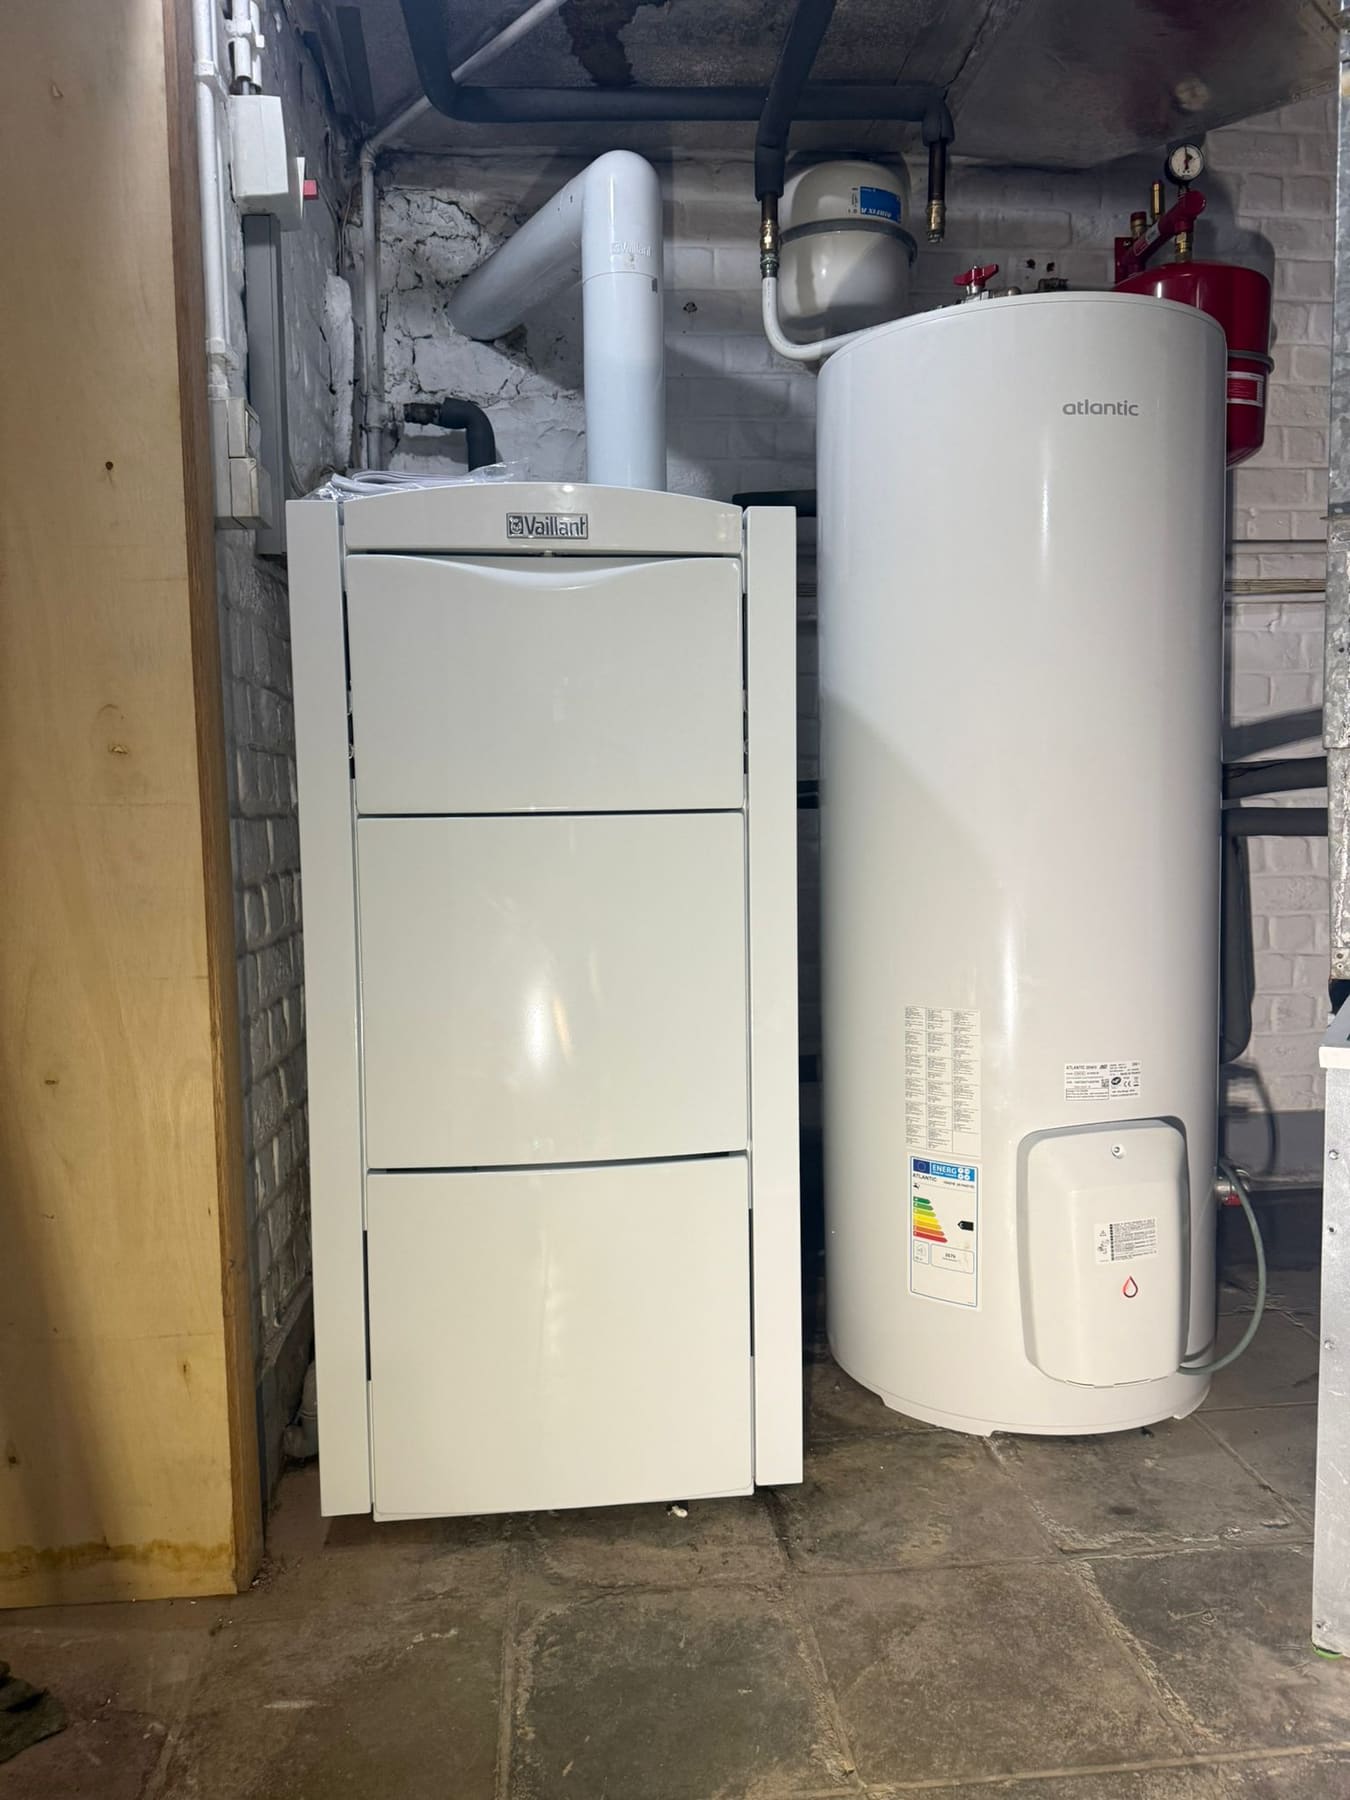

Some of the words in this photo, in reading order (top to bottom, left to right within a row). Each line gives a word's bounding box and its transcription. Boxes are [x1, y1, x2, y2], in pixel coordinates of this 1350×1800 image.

[1062, 399, 1140, 417] atlantic
[524, 515, 586, 536] Vaillant
[932, 1163, 957, 1175] ENERG
[912, 1172, 937, 1182] ATLANTIC
